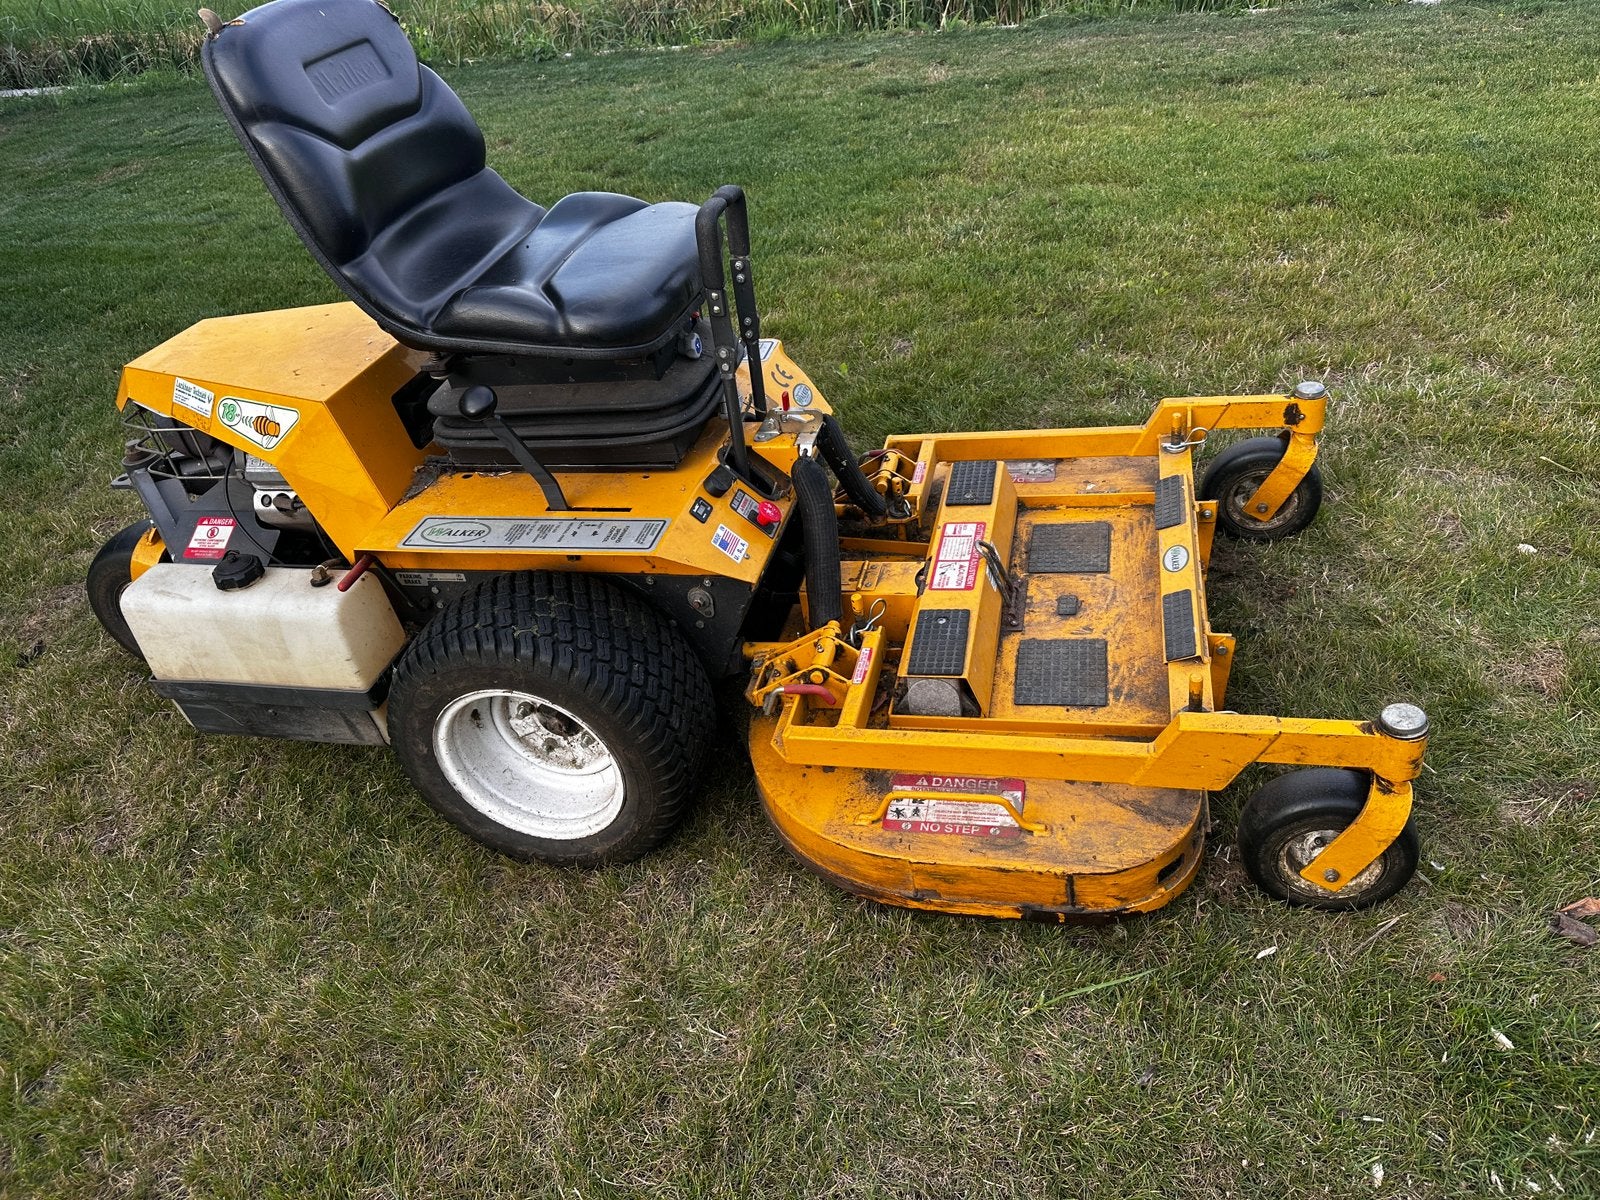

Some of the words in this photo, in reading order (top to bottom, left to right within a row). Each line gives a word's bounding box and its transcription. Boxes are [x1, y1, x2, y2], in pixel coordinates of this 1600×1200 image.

[221, 402, 237, 422] 18
[427, 527, 486, 537] WALKER
[966, 560, 978, 587] ADJUSTMENT
[931, 777, 1000, 790] DANGER
[919, 822, 941, 832] NO
[944, 823, 980, 835] STEP
